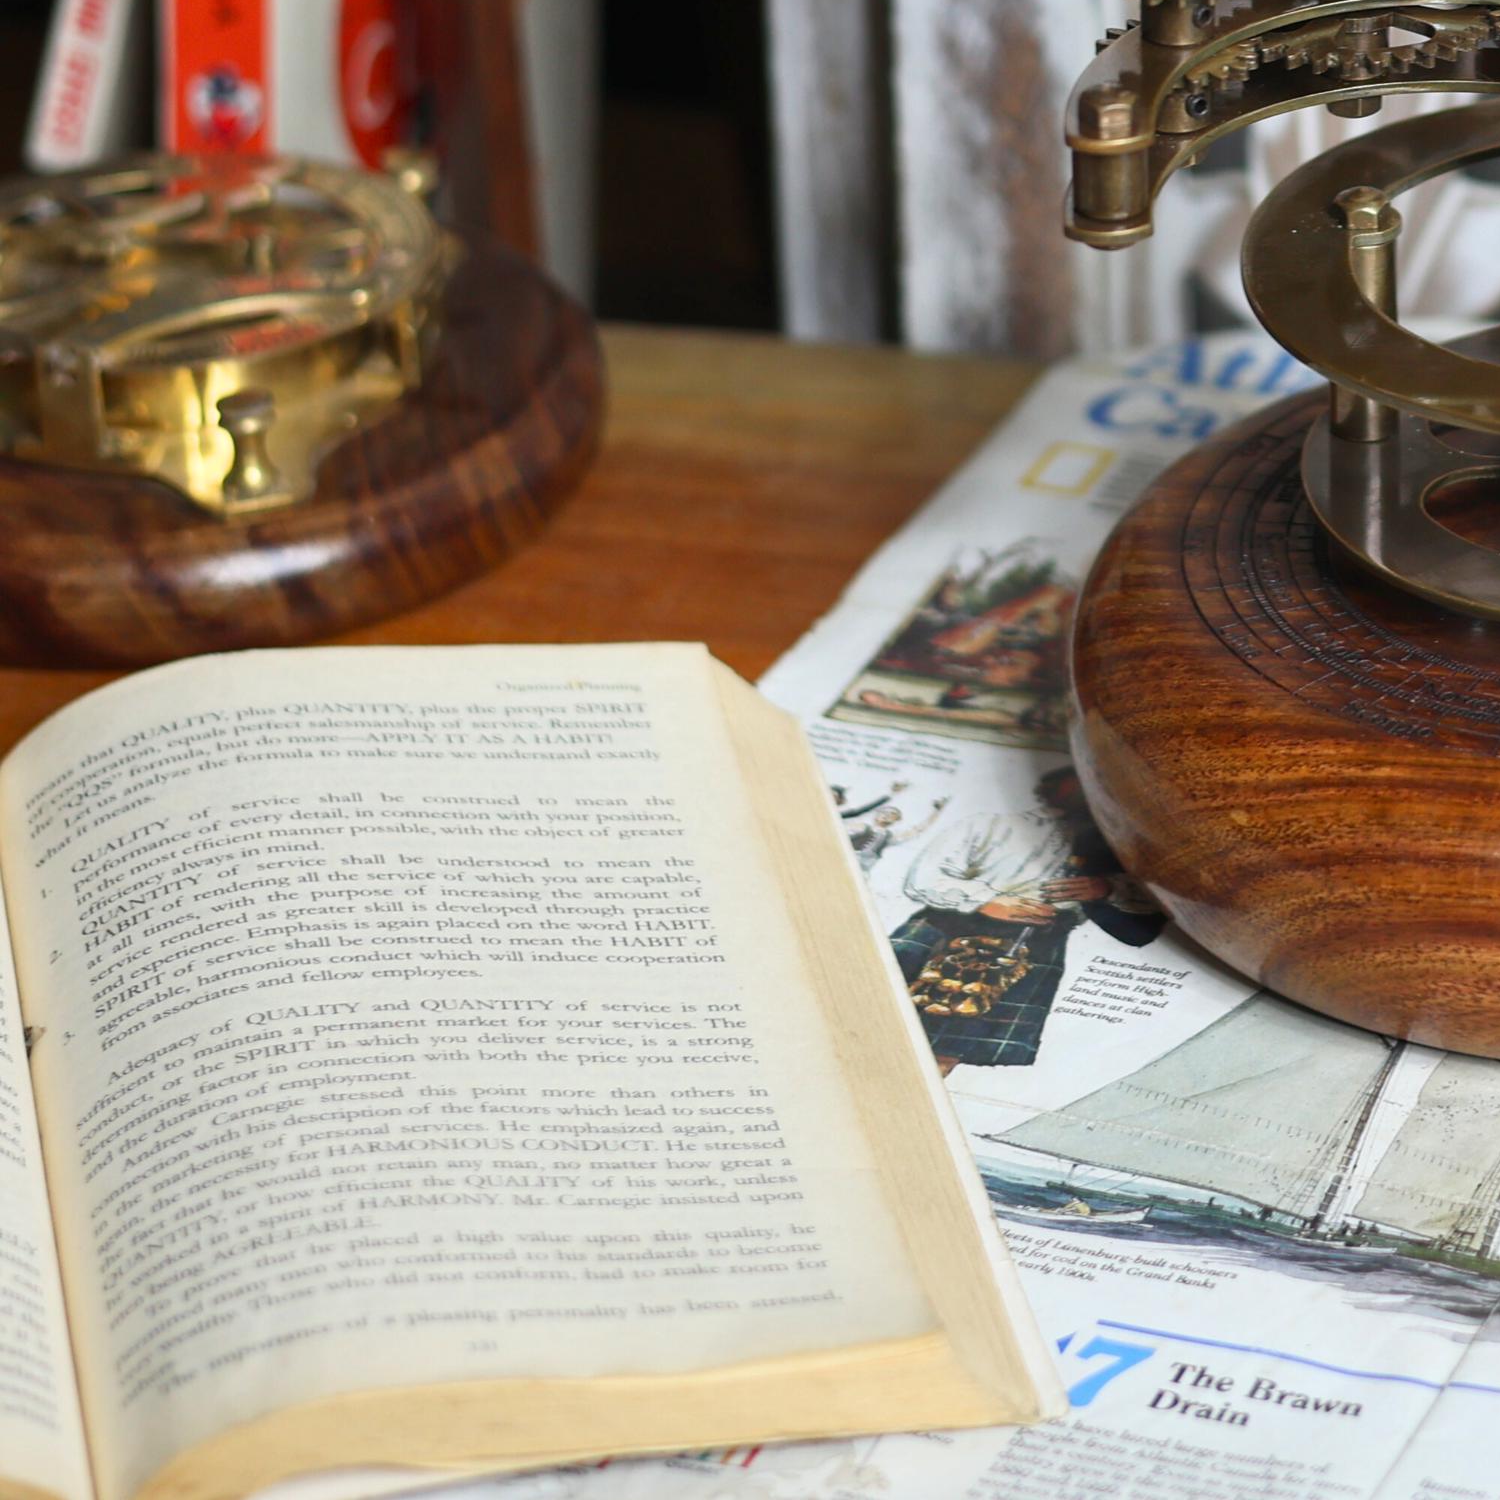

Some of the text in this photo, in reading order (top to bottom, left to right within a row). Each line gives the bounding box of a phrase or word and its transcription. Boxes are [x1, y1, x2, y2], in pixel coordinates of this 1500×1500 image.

[89, 901, 708, 984] service rendered as greater skill is developed through practice
[92, 974, 125, 1000] and
[130, 935, 241, 980] experience.
[247, 919, 347, 938] Emphasis
[354, 919, 369, 928] is
[376, 917, 429, 930] again
[435, 917, 500, 930] placed
[538, 919, 570, 928] the
[576, 920, 628, 929] word
[634, 920, 715, 929] HABIT.
[1074, 976, 1169, 997] perform High-
[1084, 965, 1183, 989] Scottish settlers
[1091, 956, 1192, 980] Descendants of
[1054, 1006, 1127, 1025] gatherings.
[1062, 995, 1152, 1017] dances at clan
[1069, 984, 1169, 1009] land music and
[108, 996, 741, 1084] Adequacy of QUALITY and QUANTITY of service is not
[1001, 1228, 1033, 1244] leets
[1035, 1238, 1052, 1249] of
[1168, 1259, 1239, 1280] schooners
[1027, 1247, 1218, 1290] for cod on the Grand Banks
[1056, 1331, 1364, 1417] 7 The Brawn
[1147, 1387, 1251, 1428] Drain
